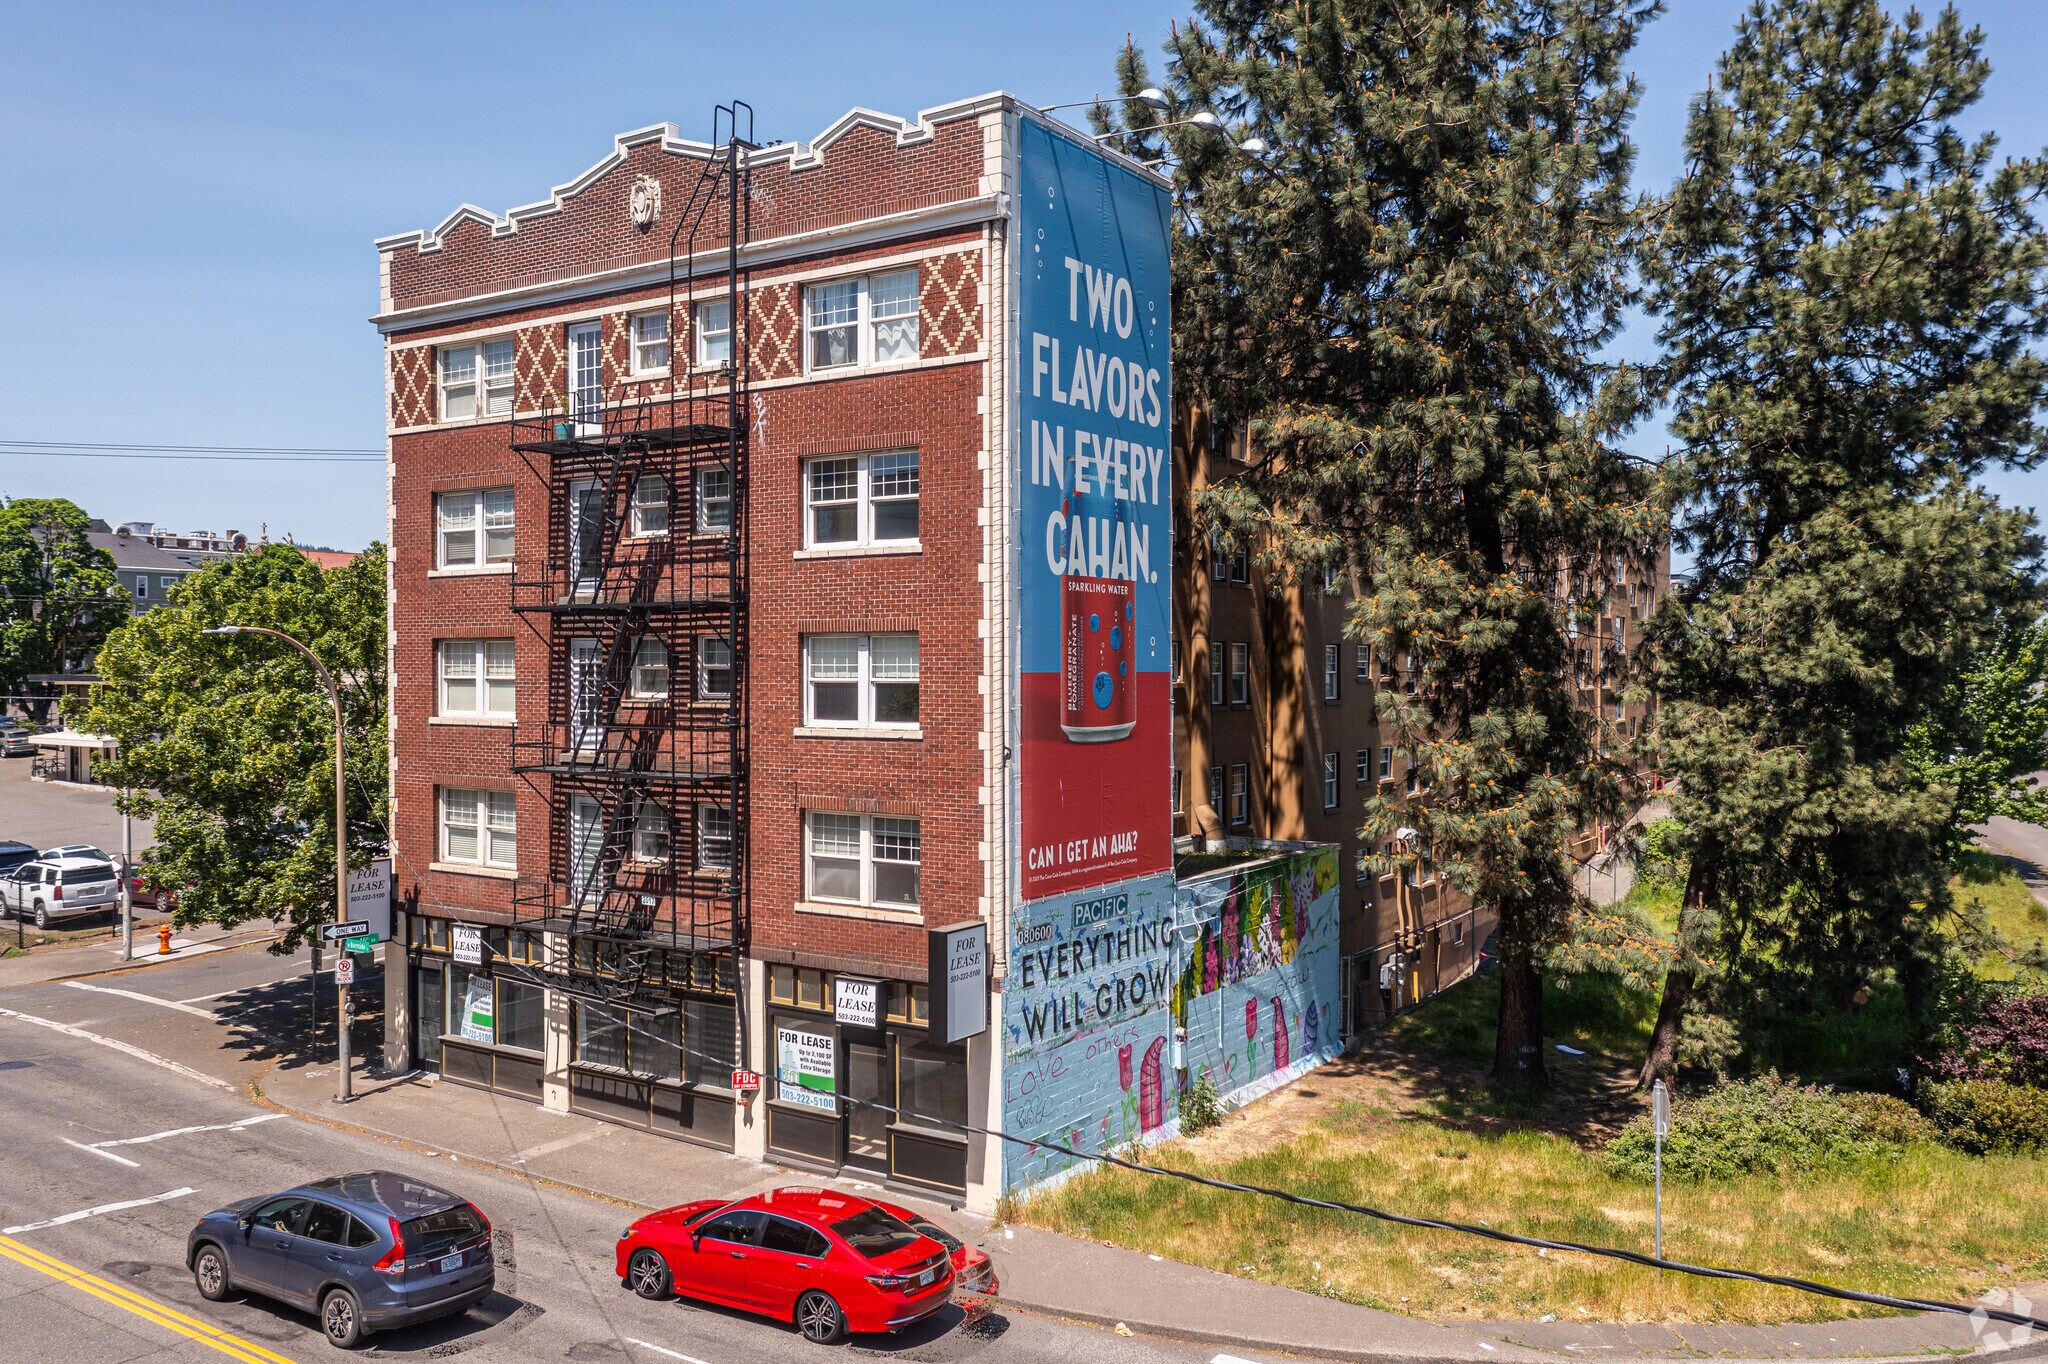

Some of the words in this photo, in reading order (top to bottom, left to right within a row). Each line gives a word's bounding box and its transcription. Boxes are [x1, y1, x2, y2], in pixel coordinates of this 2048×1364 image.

[1064, 256, 1133, 339] TWO
[1033, 332, 1161, 427] FLAVORS
[1031, 419, 1064, 490] IN
[1075, 429, 1163, 505] EVERY
[1068, 581, 1106, 594] SPARKLING
[1107, 584, 1129, 596] WATER
[1028, 844, 1054, 870] CAN
[1058, 843, 1062, 865] I
[1067, 839, 1088, 863] GET
[1091, 836, 1107, 859] AN
[357, 868, 379, 880] FOR
[350, 879, 386, 893] LEASE
[350, 892, 386, 903] 503-222-5100
[1075, 895, 1126, 926] PACIFIC
[351, 924, 365, 932] WAY
[459, 928, 476, 940] FOR
[1017, 923, 1052, 945] 080600
[454, 940, 481, 953] LEASE
[955, 936, 976, 953] FOR
[1022, 916, 1174, 988] EVERYTHING
[455, 952, 481, 963] 503-222-5100
[950, 952, 981, 971] LEASE
[950, 968, 981, 984] 503-222-5100
[476, 979, 492, 992] LEASE
[845, 982, 869, 996] FOR
[837, 997, 876, 1013] LEASE
[1021, 991, 1084, 1044] WILL
[1096, 958, 1169, 1018] GROW
[837, 1012, 876, 1024] 503-222-5100
[780, 1031, 798, 1044] FOR
[801, 1035, 832, 1050] LEASE
[799, 1048, 804, 1056] Up
[811, 1051, 825, 1059] 2,100
[800, 1063, 812, 1071] Extra
[813, 1065, 831, 1075] Storage
[810, 1058, 832, 1067] Available
[736, 1072, 756, 1084] FDC
[781, 1089, 834, 1109] 503-222-5100
